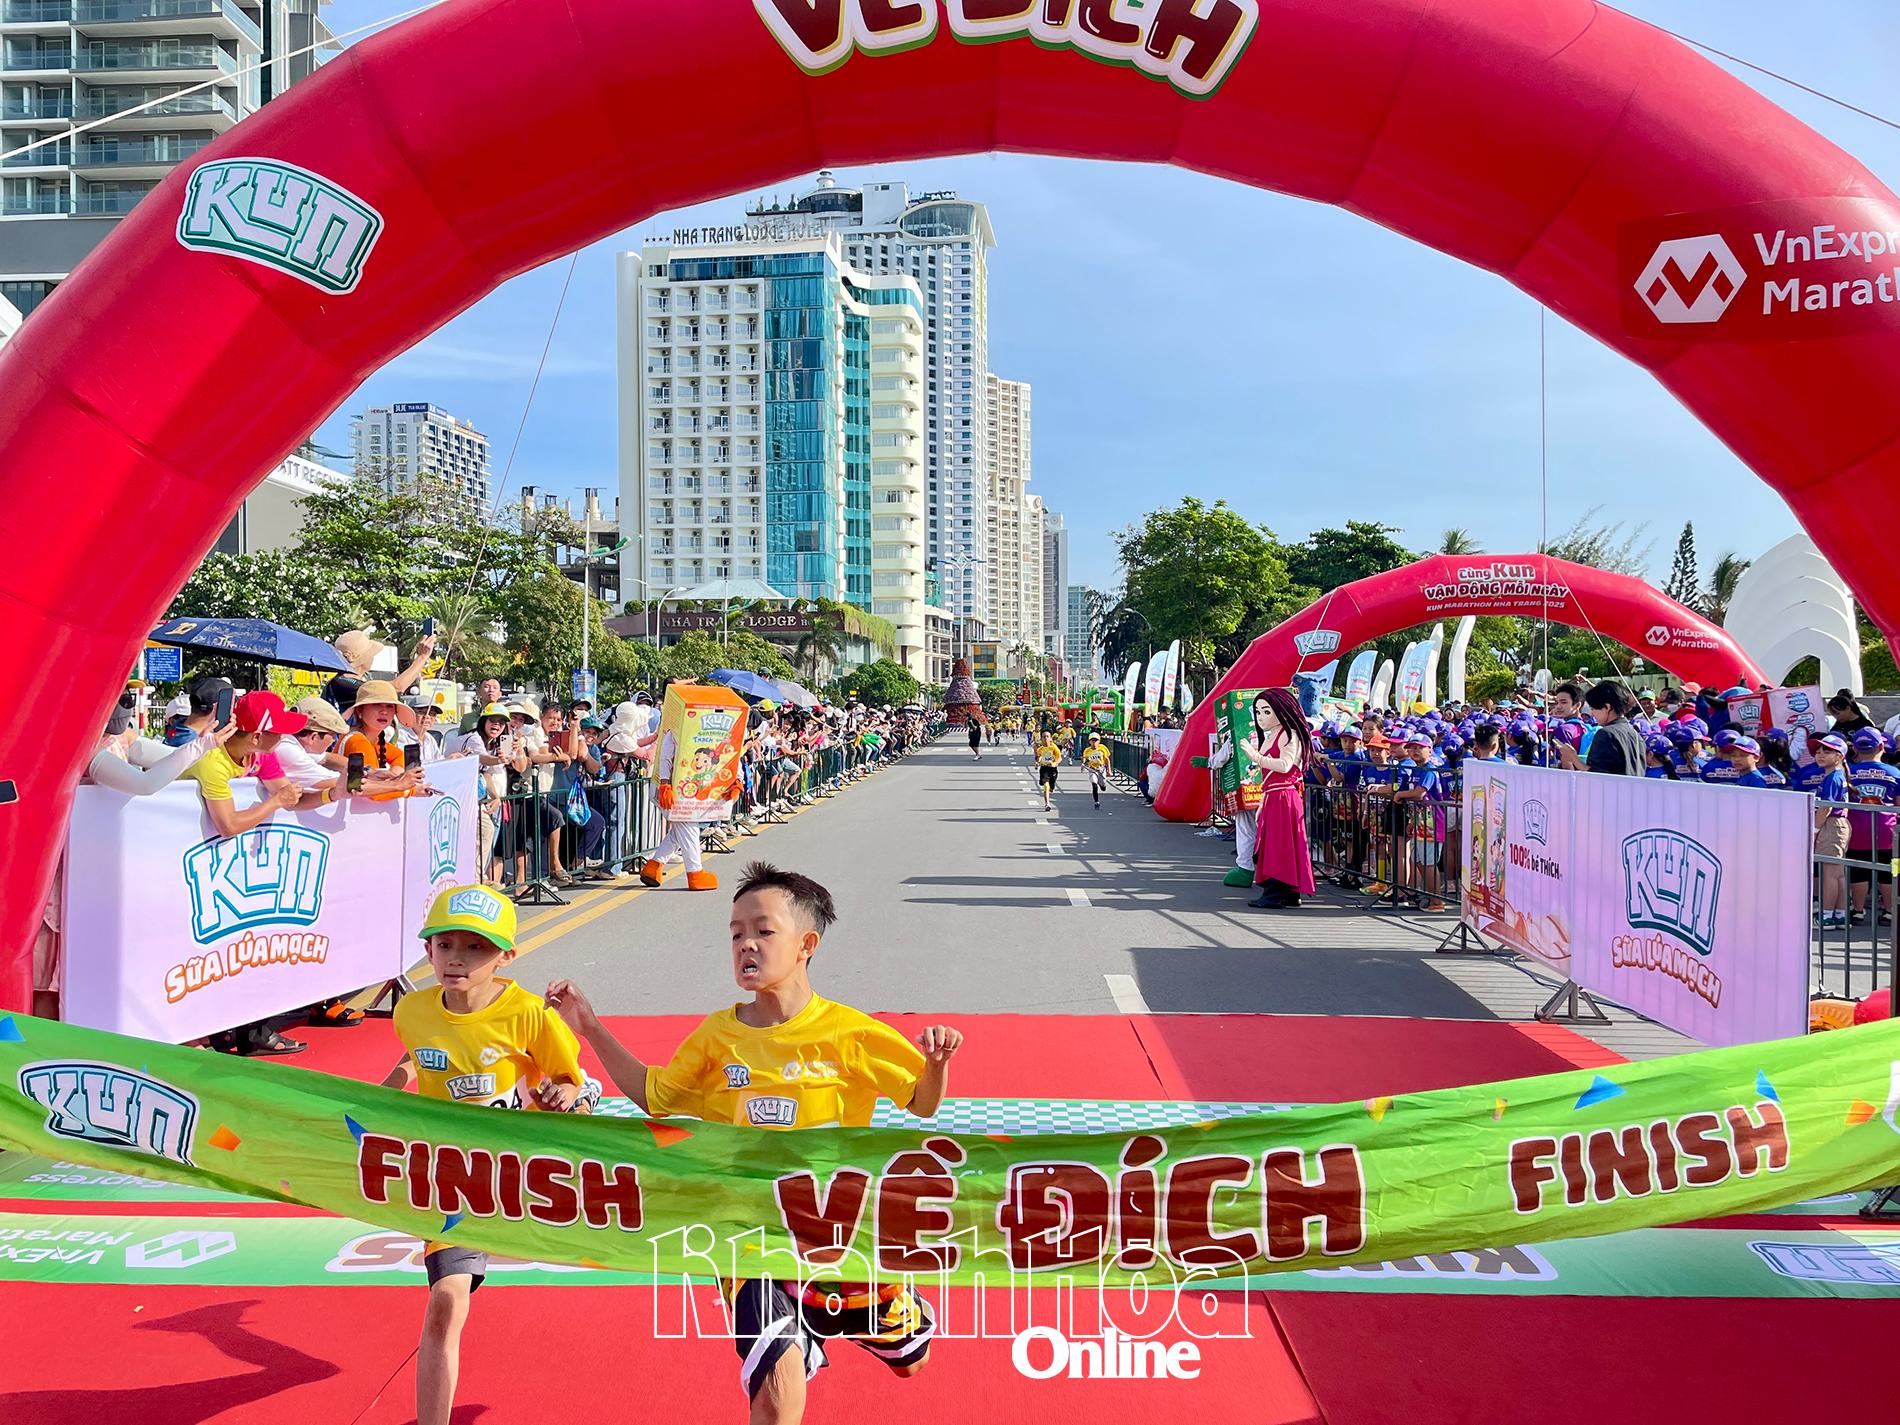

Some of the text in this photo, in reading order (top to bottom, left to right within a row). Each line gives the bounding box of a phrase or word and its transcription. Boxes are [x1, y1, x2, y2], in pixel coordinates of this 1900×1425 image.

[673, 228, 698, 245] NHA
[701, 226, 745, 244] TRANG
[745, 223, 783, 242] LODGE
[1458, 567, 1491, 580] Cùng
[1426, 580, 1568, 600] VẬN ĐỘNG MỖI NGÀY
[662, 616, 691, 627] NHA
[749, 615, 797, 628] LODGE
[1671, 638, 1719, 649] Marathon
[1509, 843, 1531, 870] 100%
[1611, 935, 1647, 969] SỮA
[164, 950, 224, 1004] SỮA
[358, 1100, 1790, 1274] FINISH VỀ ĐÍCH FINISH
